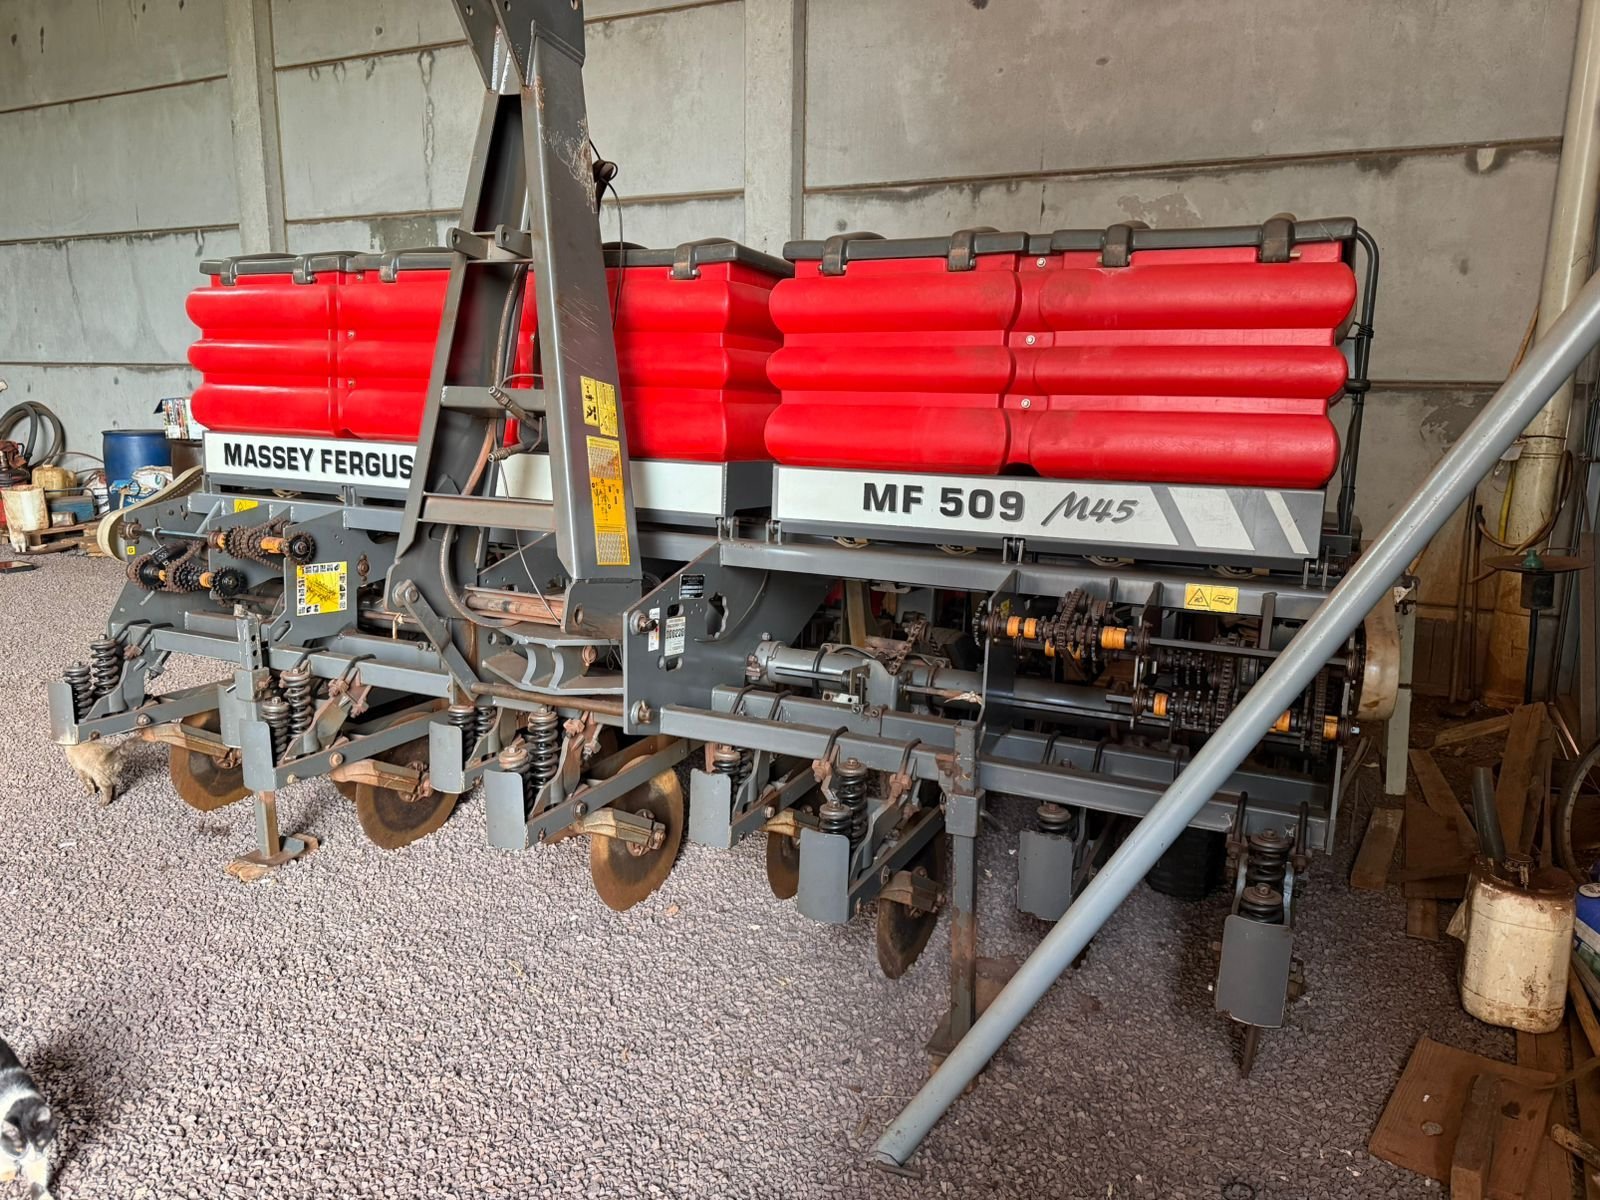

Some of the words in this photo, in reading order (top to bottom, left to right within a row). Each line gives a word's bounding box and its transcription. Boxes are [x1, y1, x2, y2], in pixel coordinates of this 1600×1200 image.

[223, 442, 313, 472] MASSEY
[863, 482, 923, 513] MF
[939, 487, 1025, 521] 509
[1040, 490, 1139, 527] M45
